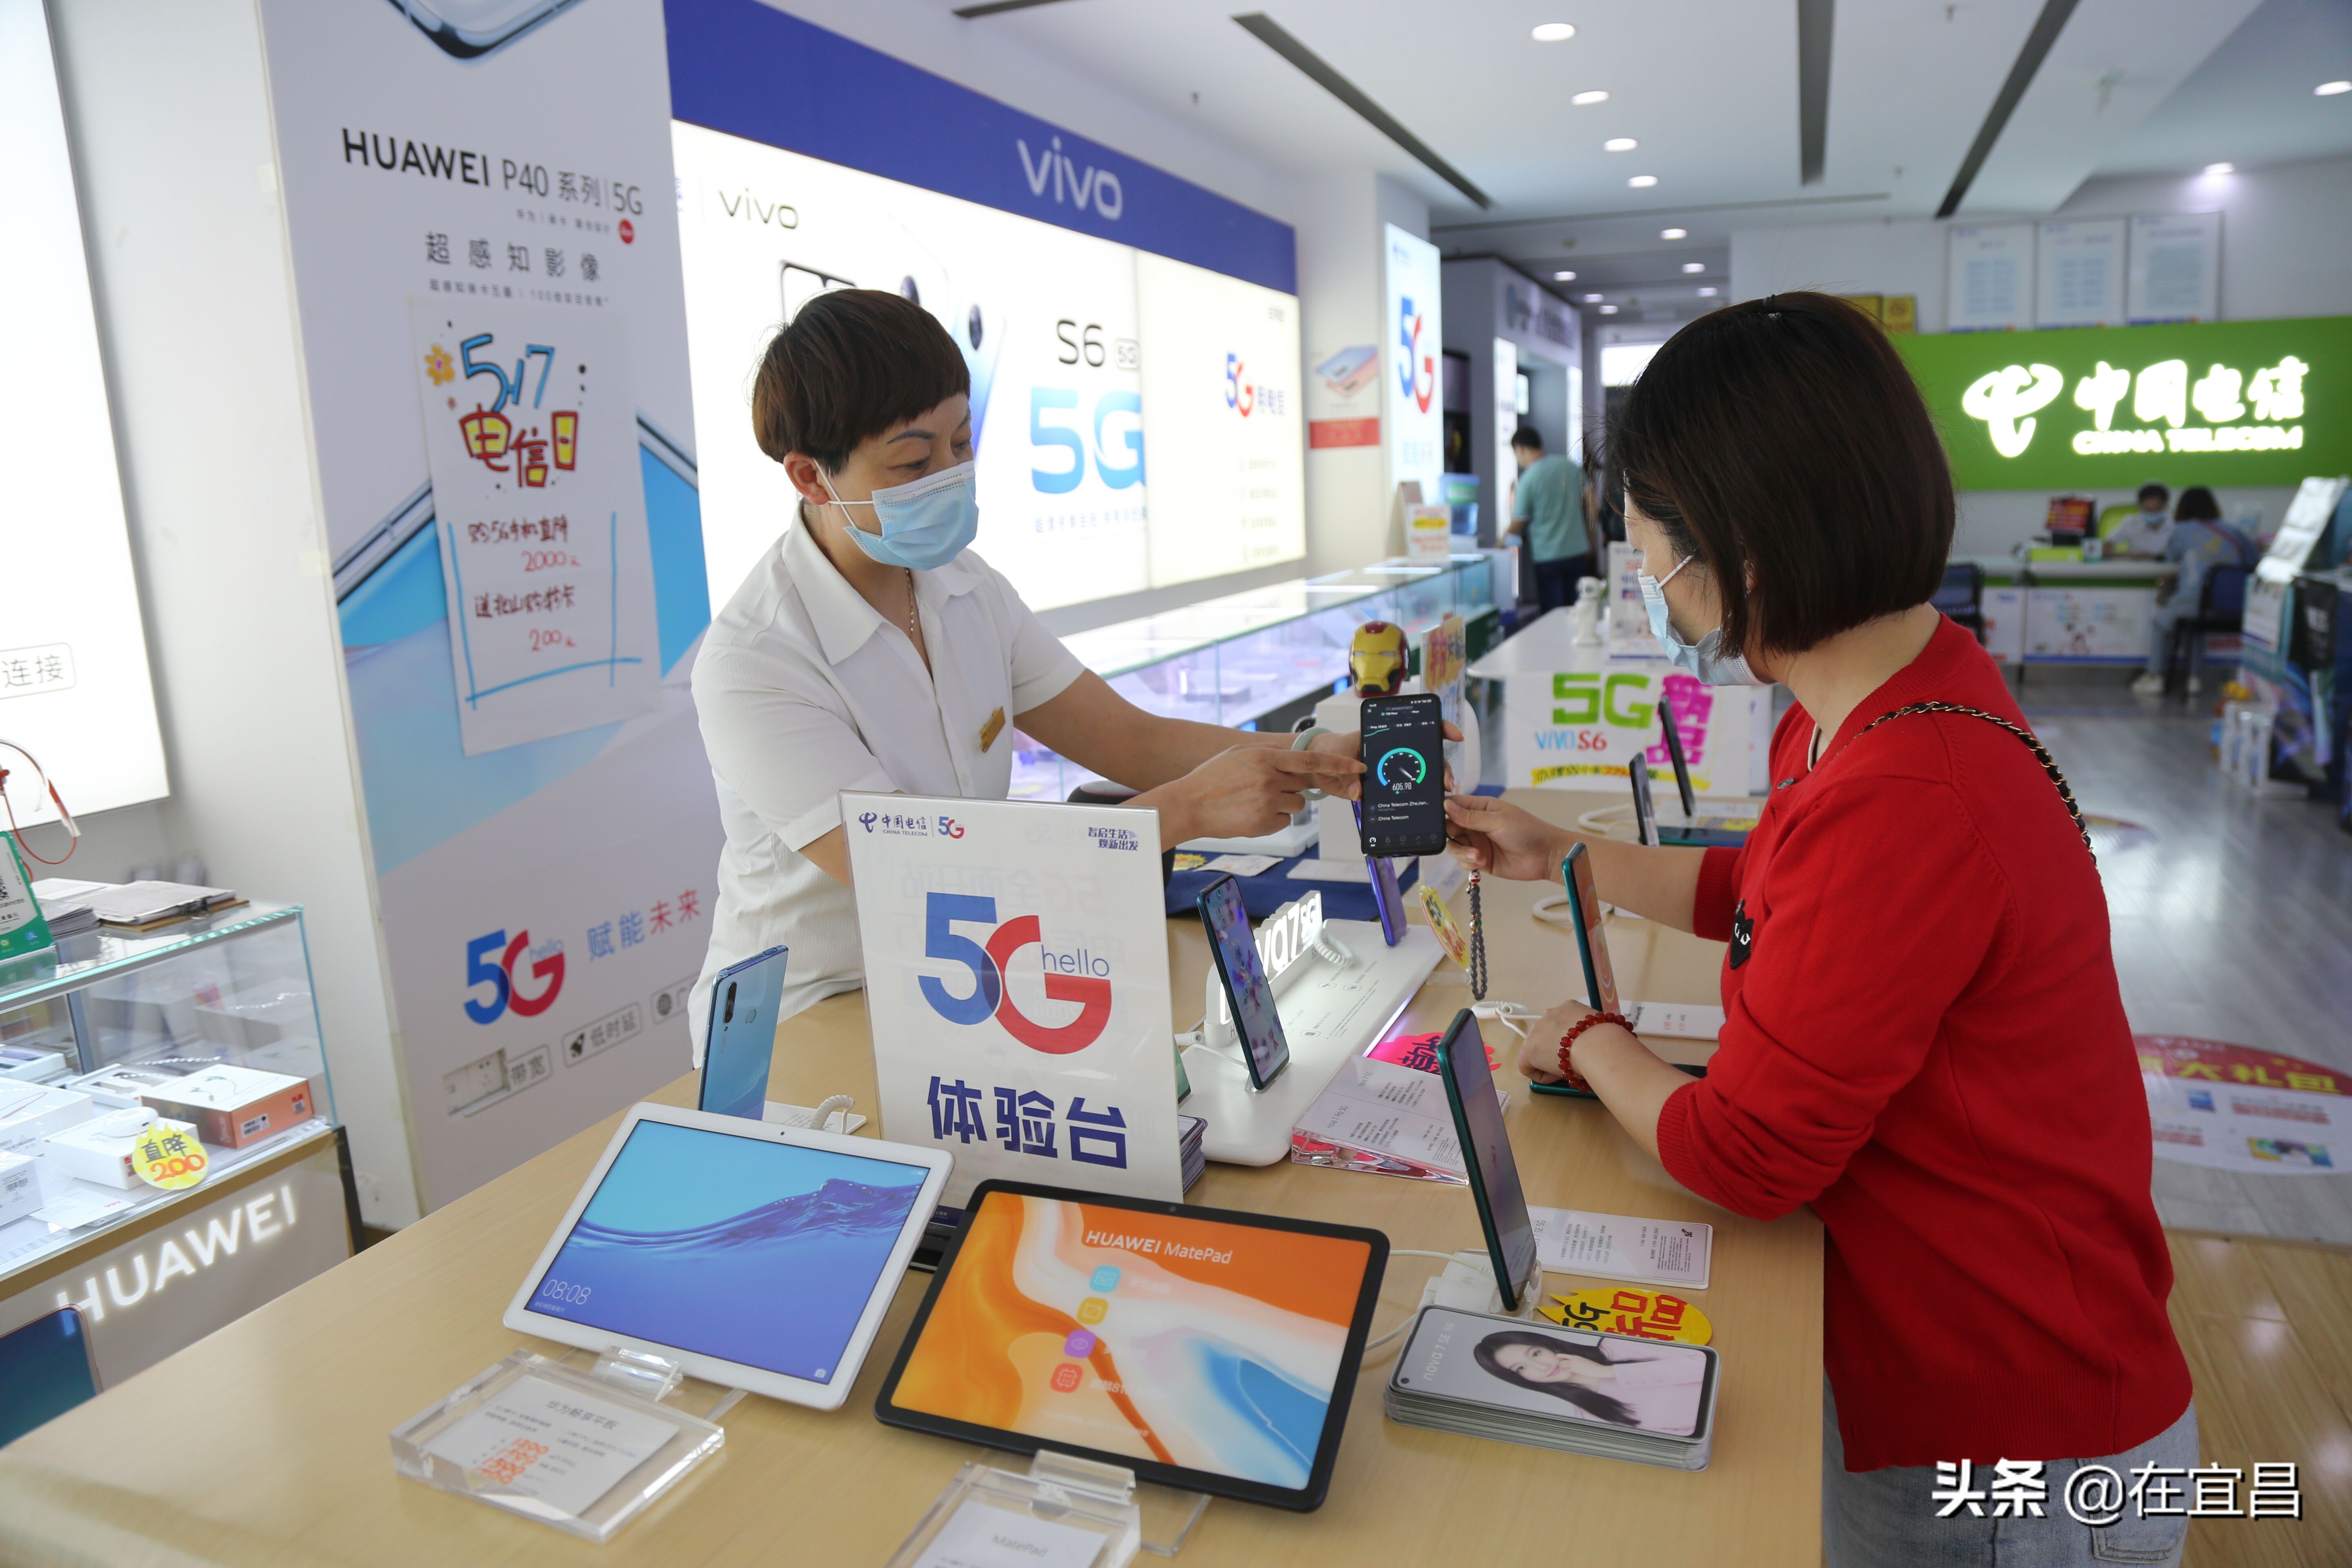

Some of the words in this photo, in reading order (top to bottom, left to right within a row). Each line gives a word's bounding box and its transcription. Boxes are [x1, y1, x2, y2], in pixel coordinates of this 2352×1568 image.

[342, 128, 490, 187] HUAWEI
[503, 159, 548, 198] P40
[557, 172, 601, 207] 系列
[613, 181, 643, 216] 5G
[1017, 136, 1123, 220] vivo
[719, 187, 798, 229] vivo
[425, 230, 600, 283] 超感知影像
[1057, 319, 1105, 368] S6
[1398, 296, 1434, 414] 5G
[1225, 353, 1254, 417] 5G
[2074, 356, 2309, 432] 中国电信
[459, 403, 578, 488] 电信日
[1030, 386, 1146, 494] 5G
[2, 654, 64, 688] 连接
[1553, 673, 1655, 728] 5G
[1578, 730, 1608, 751] S6
[1392, 782, 1412, 791] 605.98
[882, 813, 927, 830] 中国电信
[938, 816, 964, 839] 5G
[586, 889, 701, 962] 赋能未来
[463, 929, 565, 1026] 5G
[918, 892, 1112, 1055] 5G
[1041, 944, 1110, 977] hello
[140, 1133, 190, 1163] 直降
[927, 1076, 1128, 1169] 体验台
[1327, 1120, 1337, 1129] nova
[151, 1154, 205, 1183] 200
[56, 1185, 296, 1322] HUAWEI
[1086, 1230, 1161, 1254] HUAWEI
[1164, 1242, 1234, 1265] MatePad
[543, 1279, 591, 1305] 08:08
[1423, 1352, 1444, 1381] nova
[1439, 1333, 1451, 1344] SE
[992, 1534, 1047, 1558] MatePad
